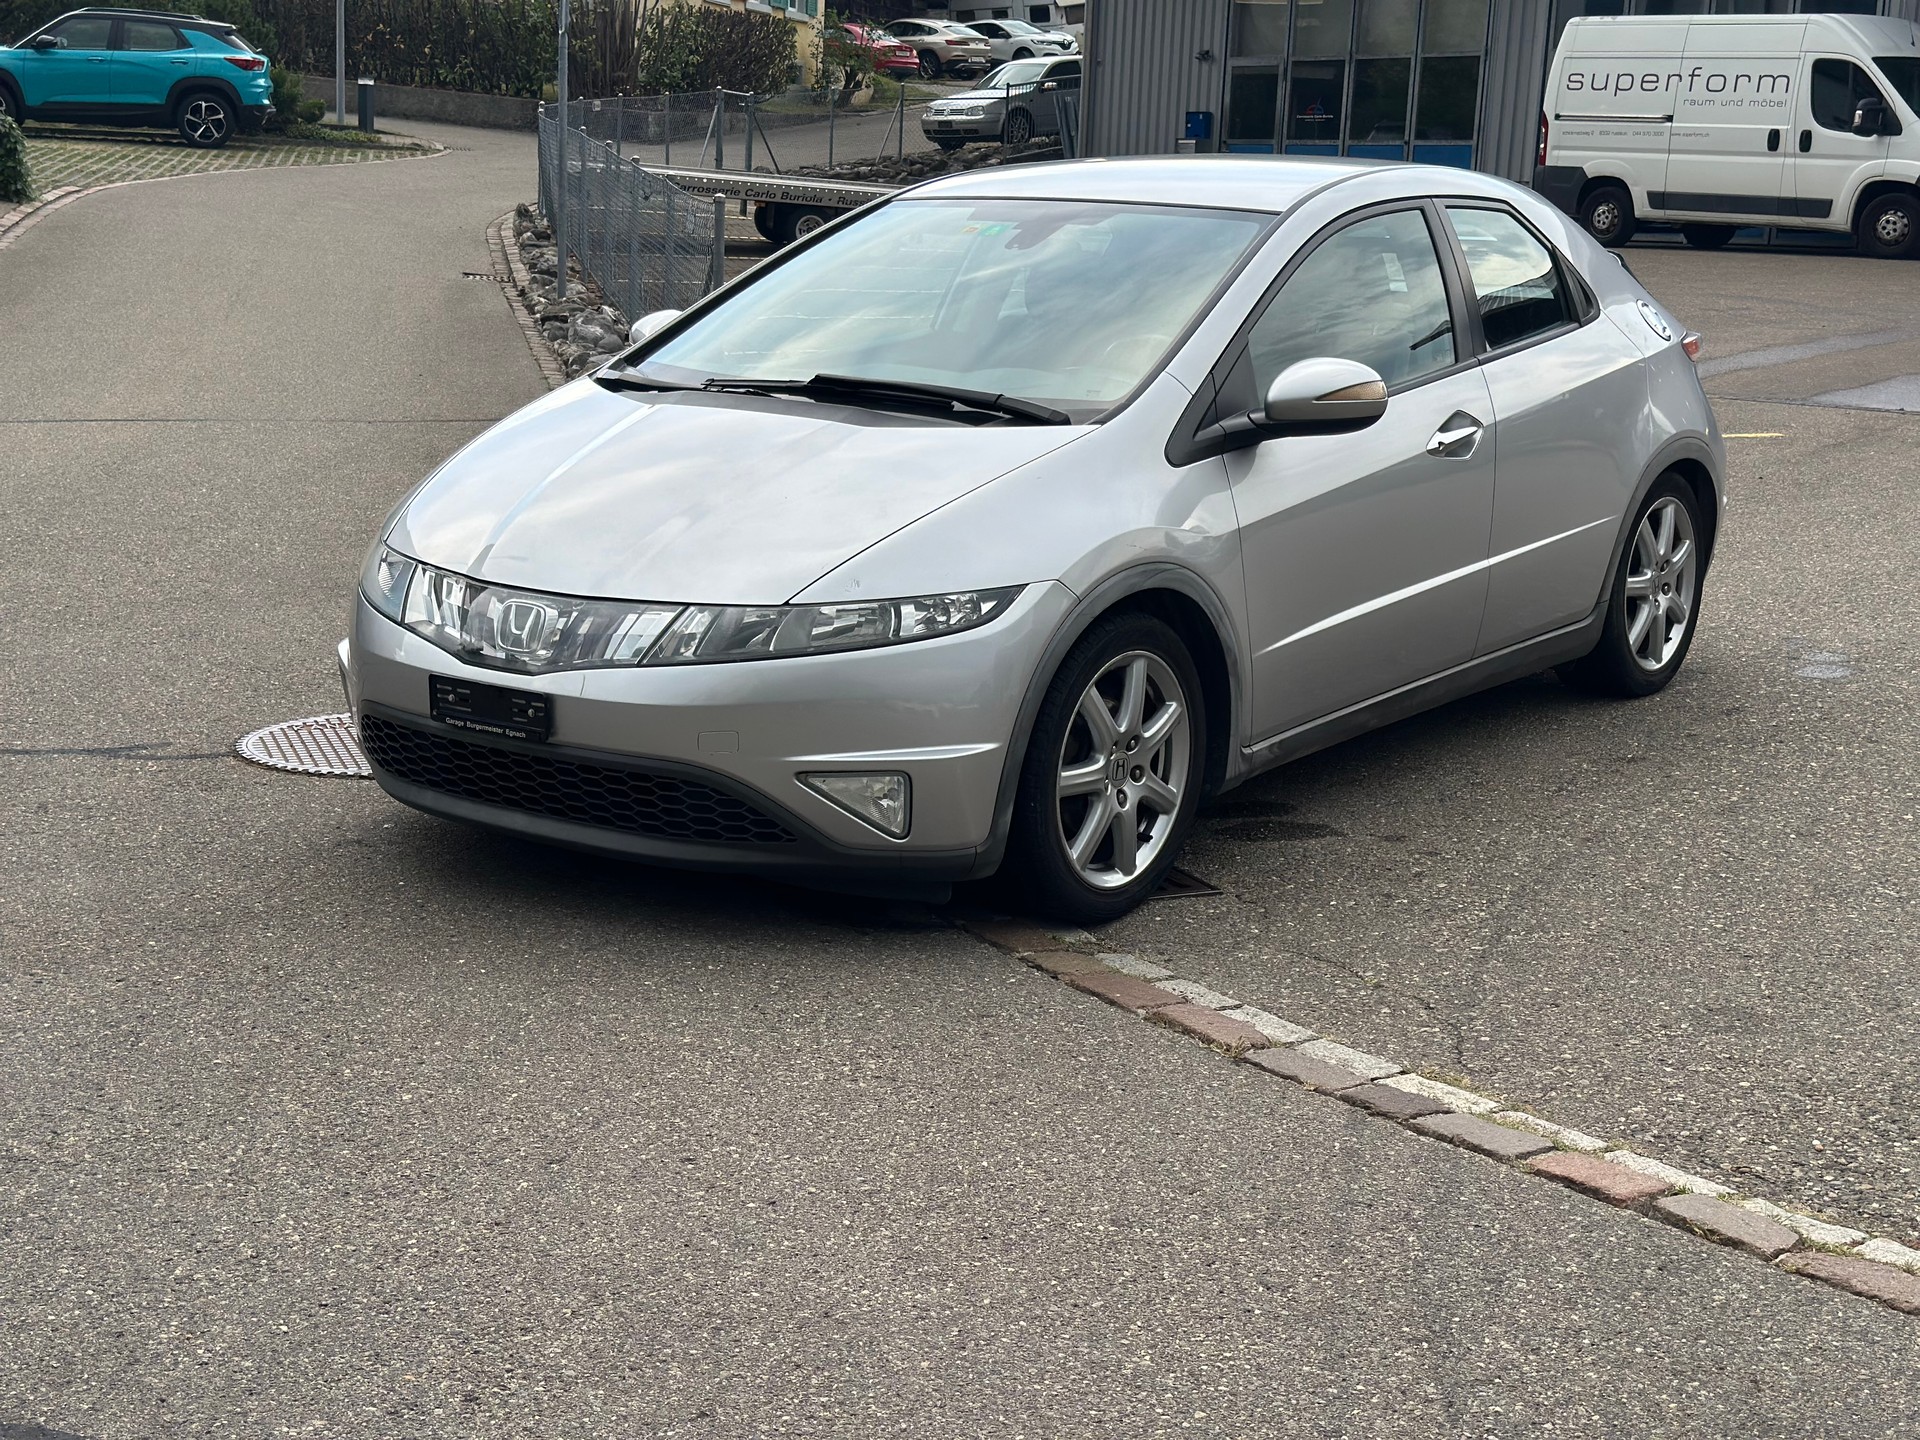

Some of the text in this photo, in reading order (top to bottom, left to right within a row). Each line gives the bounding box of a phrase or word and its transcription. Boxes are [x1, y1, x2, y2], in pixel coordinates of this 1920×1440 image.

[1565, 66, 1791, 97] superform
[1682, 98, 1787, 108] raum und möbel
[744, 188, 776, 199] Carlo
[781, 191, 823, 204] Buriola
[445, 717, 464, 727] Garage
[505, 729, 526, 738] Egnach
